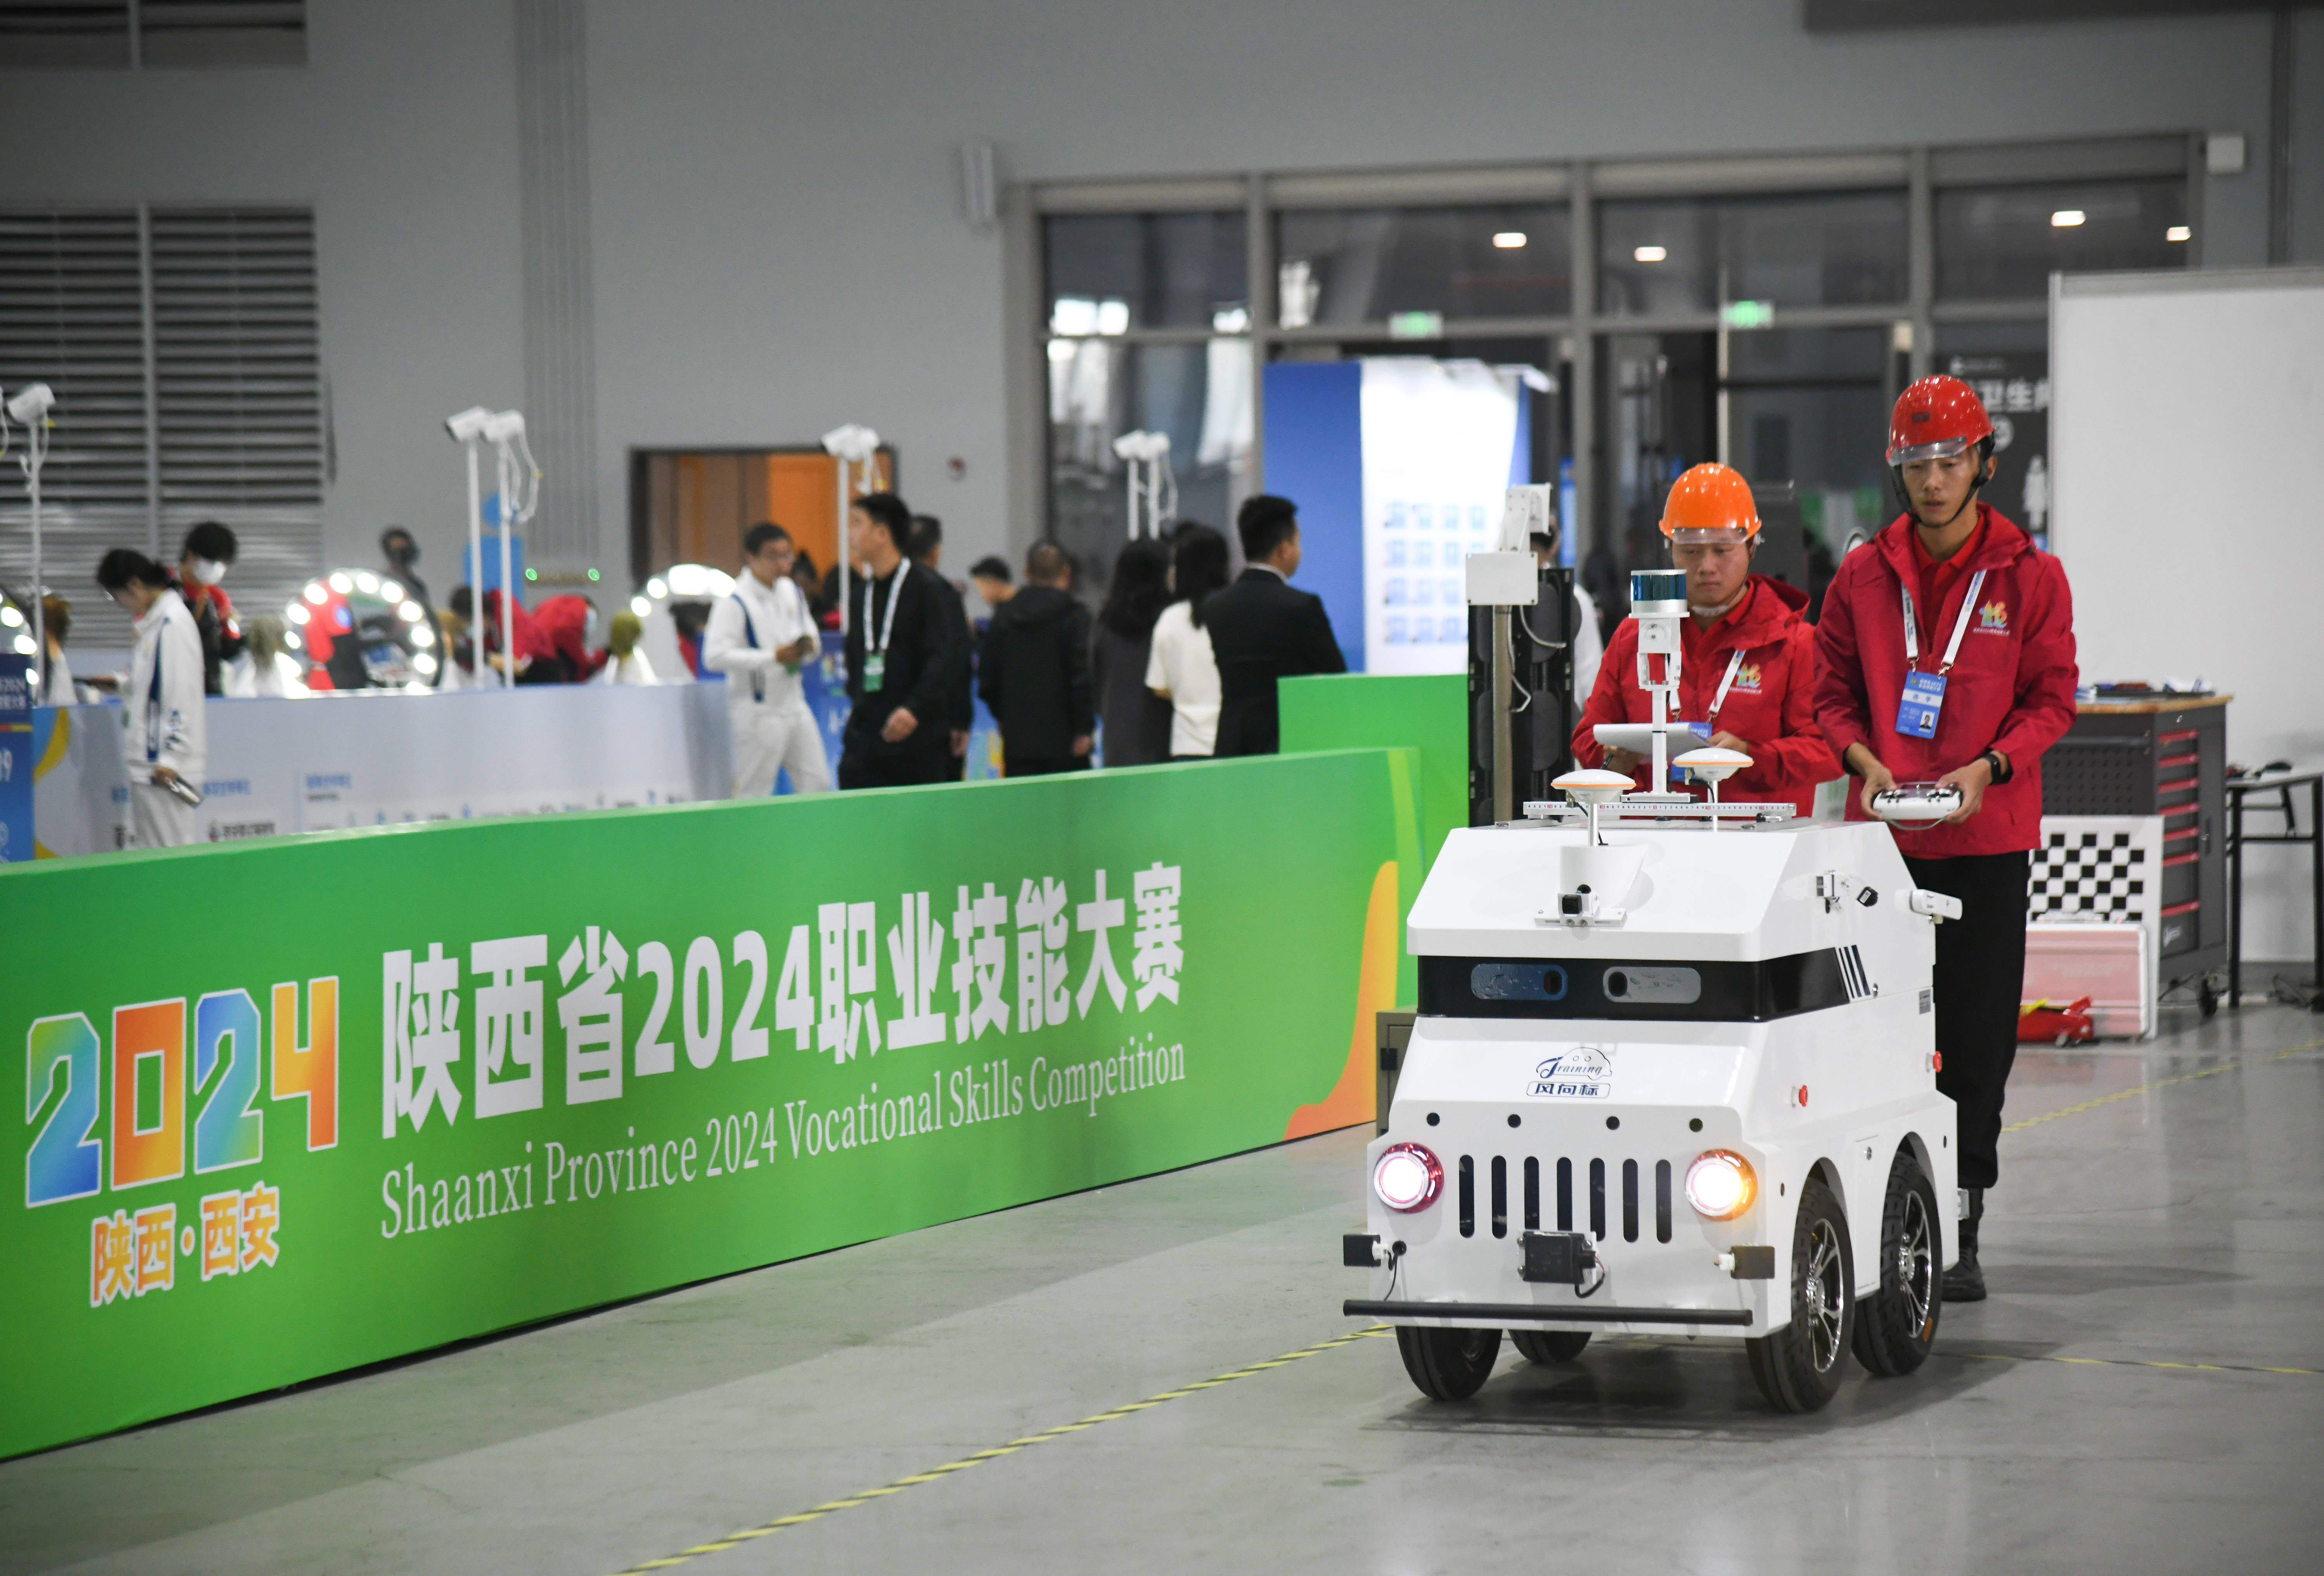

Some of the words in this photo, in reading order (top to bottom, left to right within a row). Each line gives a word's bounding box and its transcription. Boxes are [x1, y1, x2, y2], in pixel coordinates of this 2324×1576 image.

[26, 975, 339, 1208] 2024
[383, 861, 1184, 1139] 陕西省2024职业技能大赛
[1535, 1083, 1599, 1096] 风向标
[382, 1142, 533, 1238] Shaanxi
[545, 1127, 697, 1204] Province
[707, 1108, 777, 1177] 2024
[784, 1070, 943, 1159] Vocational
[950, 1059, 1023, 1128] Skills
[1030, 1032, 1185, 1116] Competition
[91, 1181, 279, 1308] 陕西·西安
